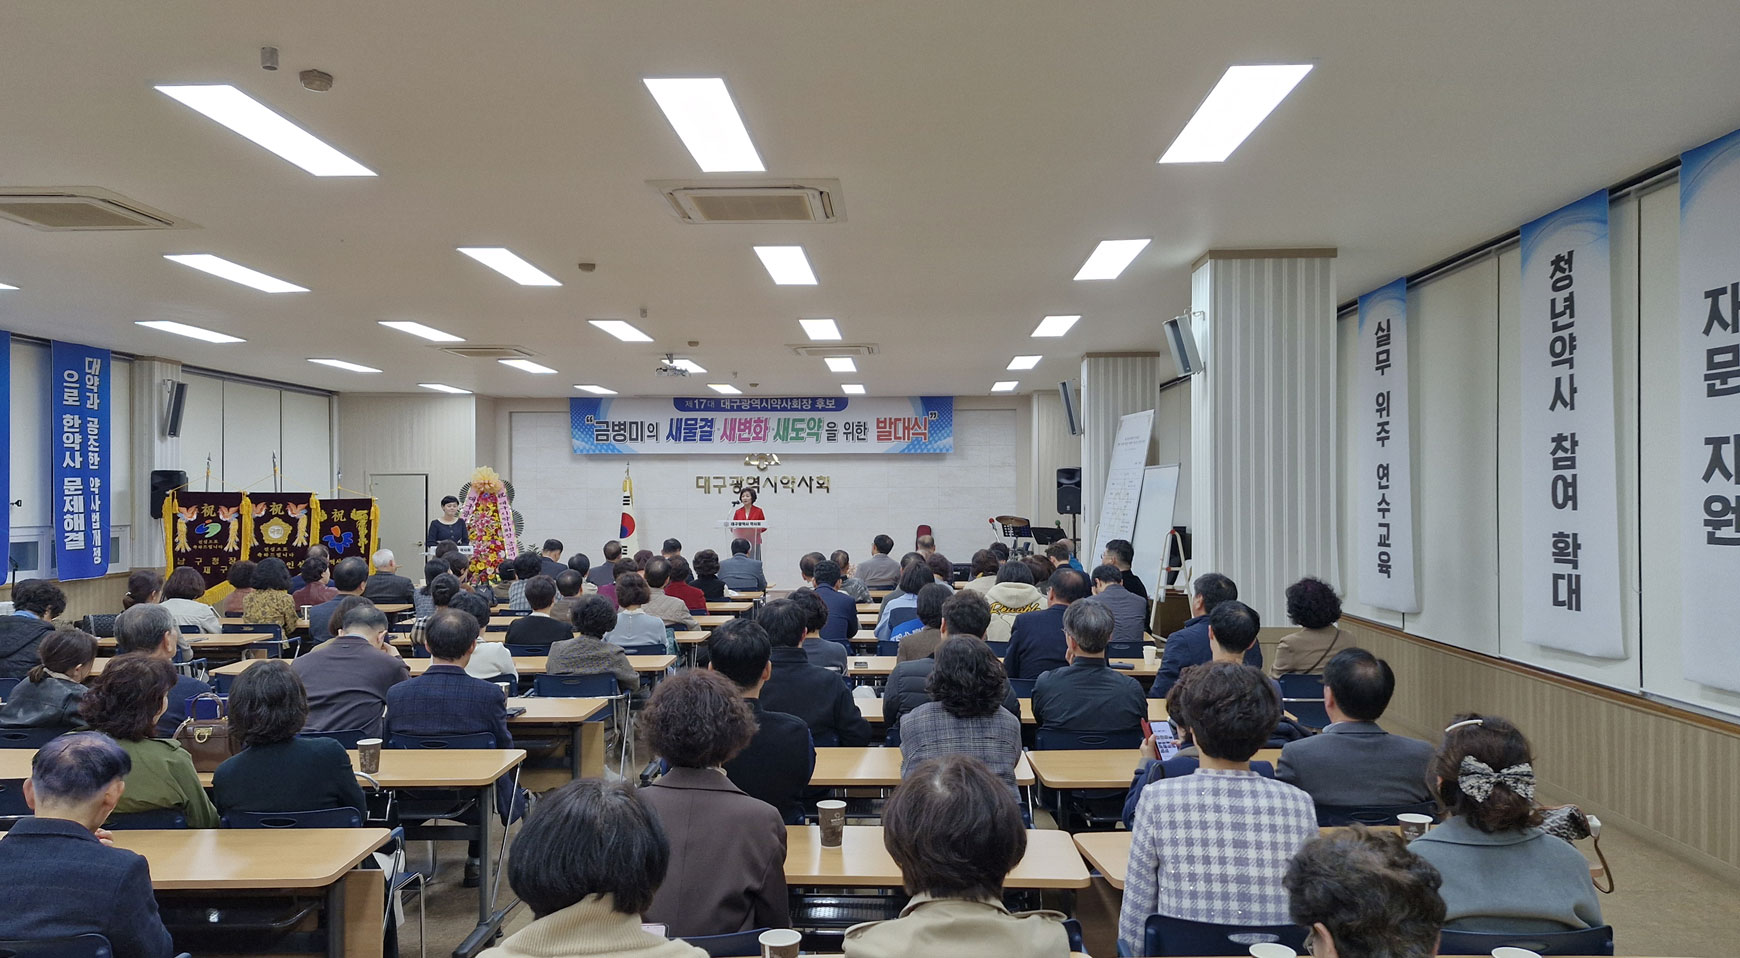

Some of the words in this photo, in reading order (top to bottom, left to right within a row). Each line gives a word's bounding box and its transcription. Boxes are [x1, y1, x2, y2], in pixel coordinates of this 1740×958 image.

[1374, 318, 1391, 376] 실무
[1549, 249, 1578, 412] 청년약사
[62, 369, 80, 406] 으로
[85, 357, 101, 410] 대약과
[684, 399, 715, 409] 제17대
[720, 398, 812, 410] 대구광역시약사회장
[815, 399, 836, 409] 후보
[62, 414, 83, 469] 한약사
[87, 417, 100, 470] 공조한
[843, 421, 868, 441] 위한
[1375, 390, 1391, 448] 위주
[695, 475, 831, 494] 대구광역시약사회
[1550, 432, 1579, 511] 참여
[63, 477, 85, 551] 문제해결
[89, 476, 102, 565] 약사법개정
[202, 503, 217, 517] 祝
[269, 502, 285, 515] 祝
[331, 508, 347, 522] 祝
[1376, 463, 1391, 579] 연수교육
[1551, 531, 1581, 612] 확대
